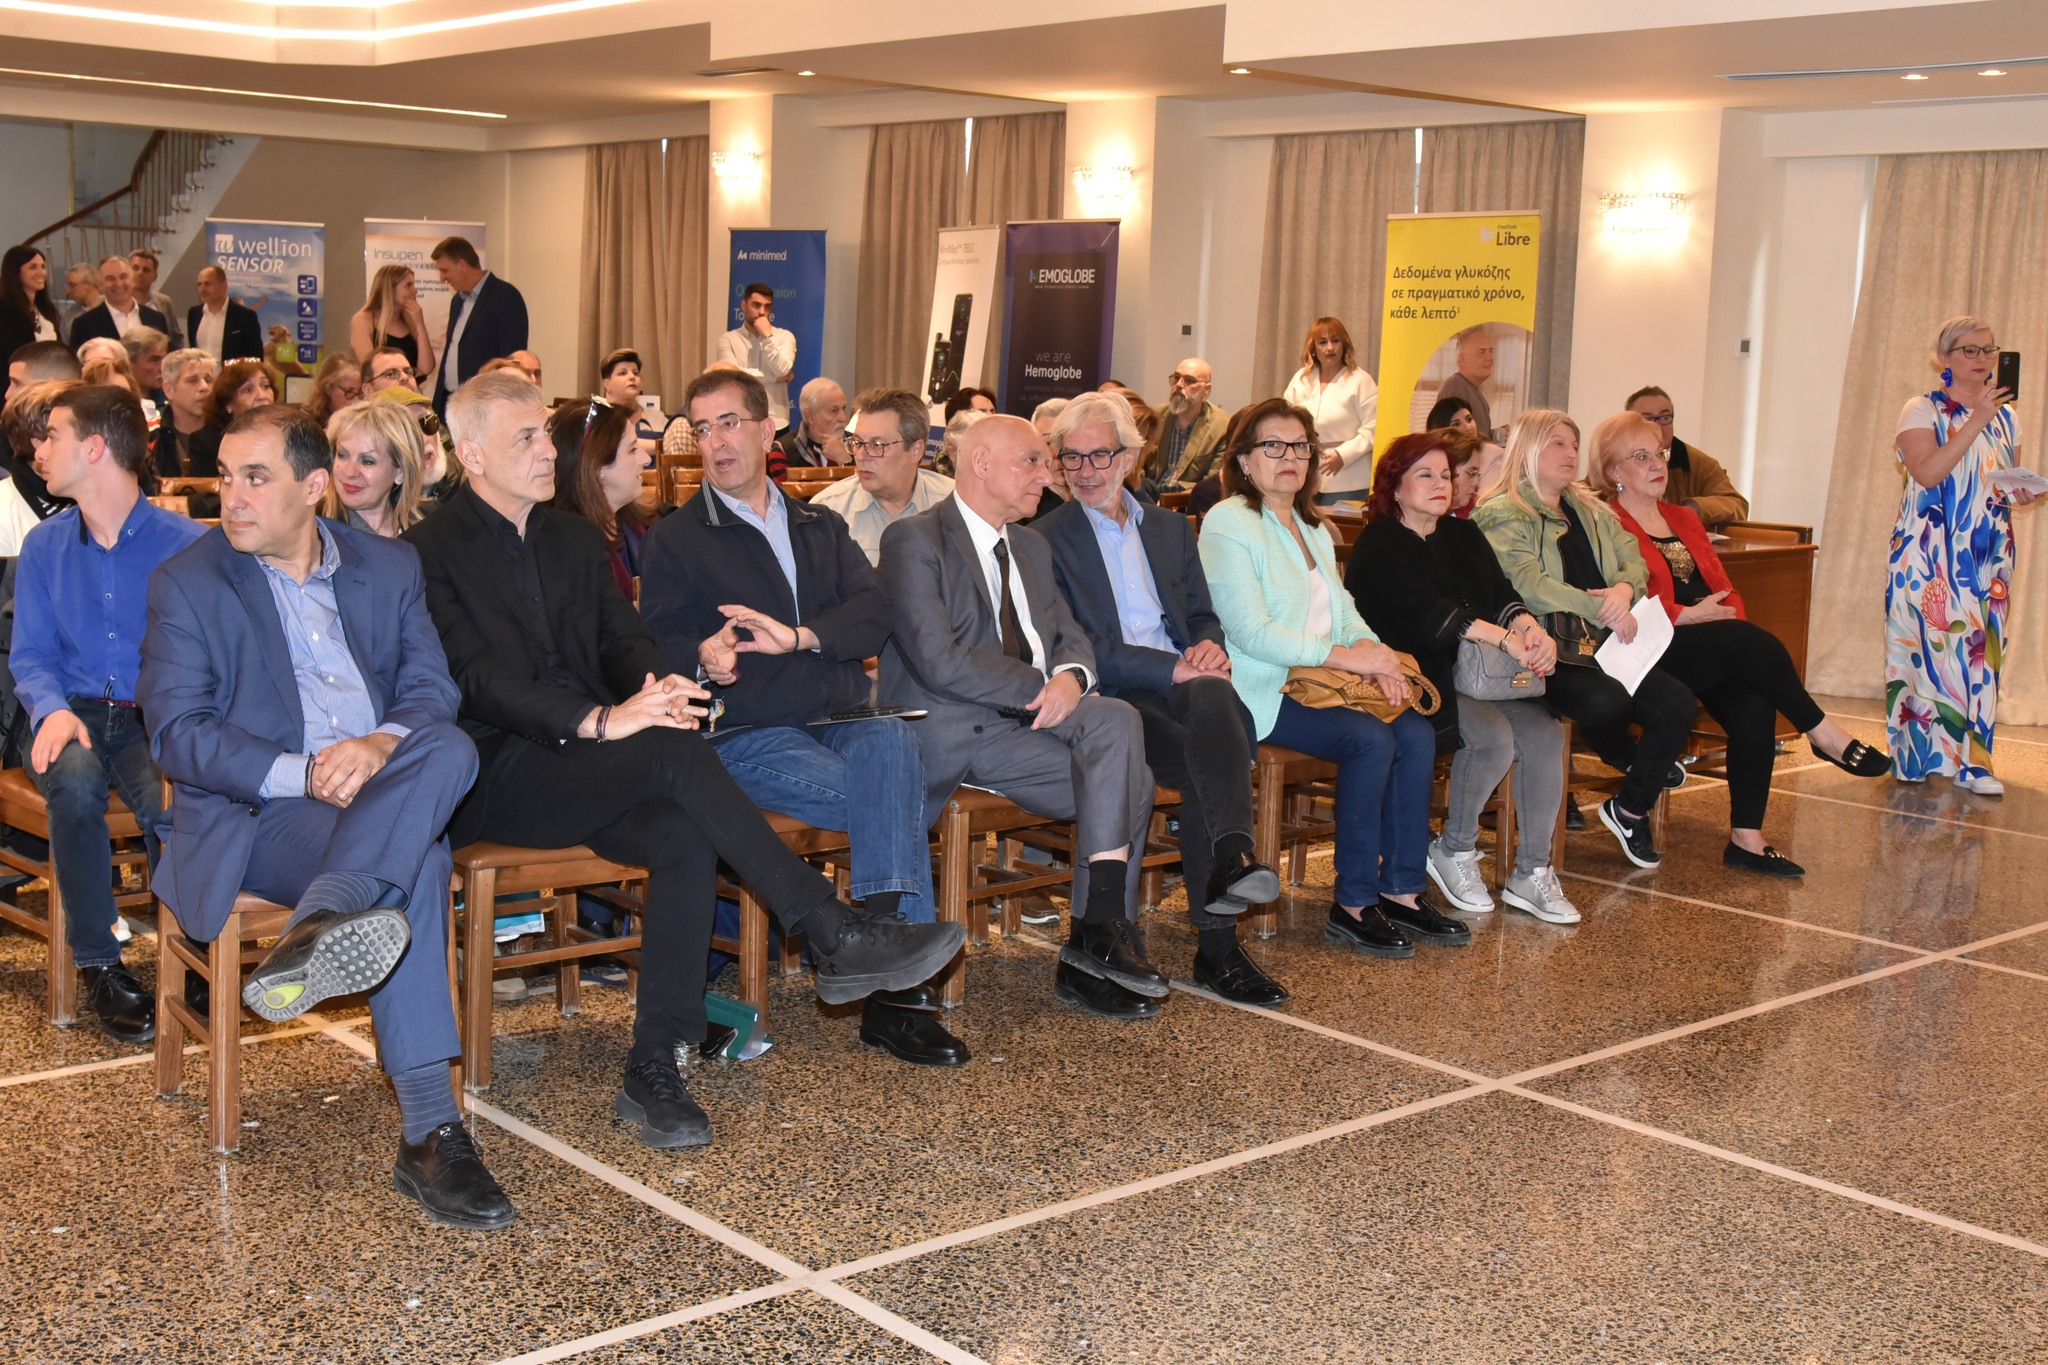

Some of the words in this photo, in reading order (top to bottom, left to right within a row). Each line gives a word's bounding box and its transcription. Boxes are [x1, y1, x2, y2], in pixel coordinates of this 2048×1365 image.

[1496, 231, 1531, 246] Libre
[374, 249, 424, 261] Insupen
[749, 250, 788, 261] minimed
[217, 255, 284, 273] SENSOR
[1393, 266, 1452, 281] Δεδομένα
[1455, 265, 1511, 281] γλυκόζης
[1391, 288, 1405, 299] σε
[1407, 286, 1481, 301] πραγματικό
[1483, 286, 1526, 302] χρόνο,
[1390, 306, 1418, 319] κάθε
[1035, 352, 1051, 362] we
[1053, 352, 1072, 363] are
[1025, 363, 1083, 381] Hemoglobe
